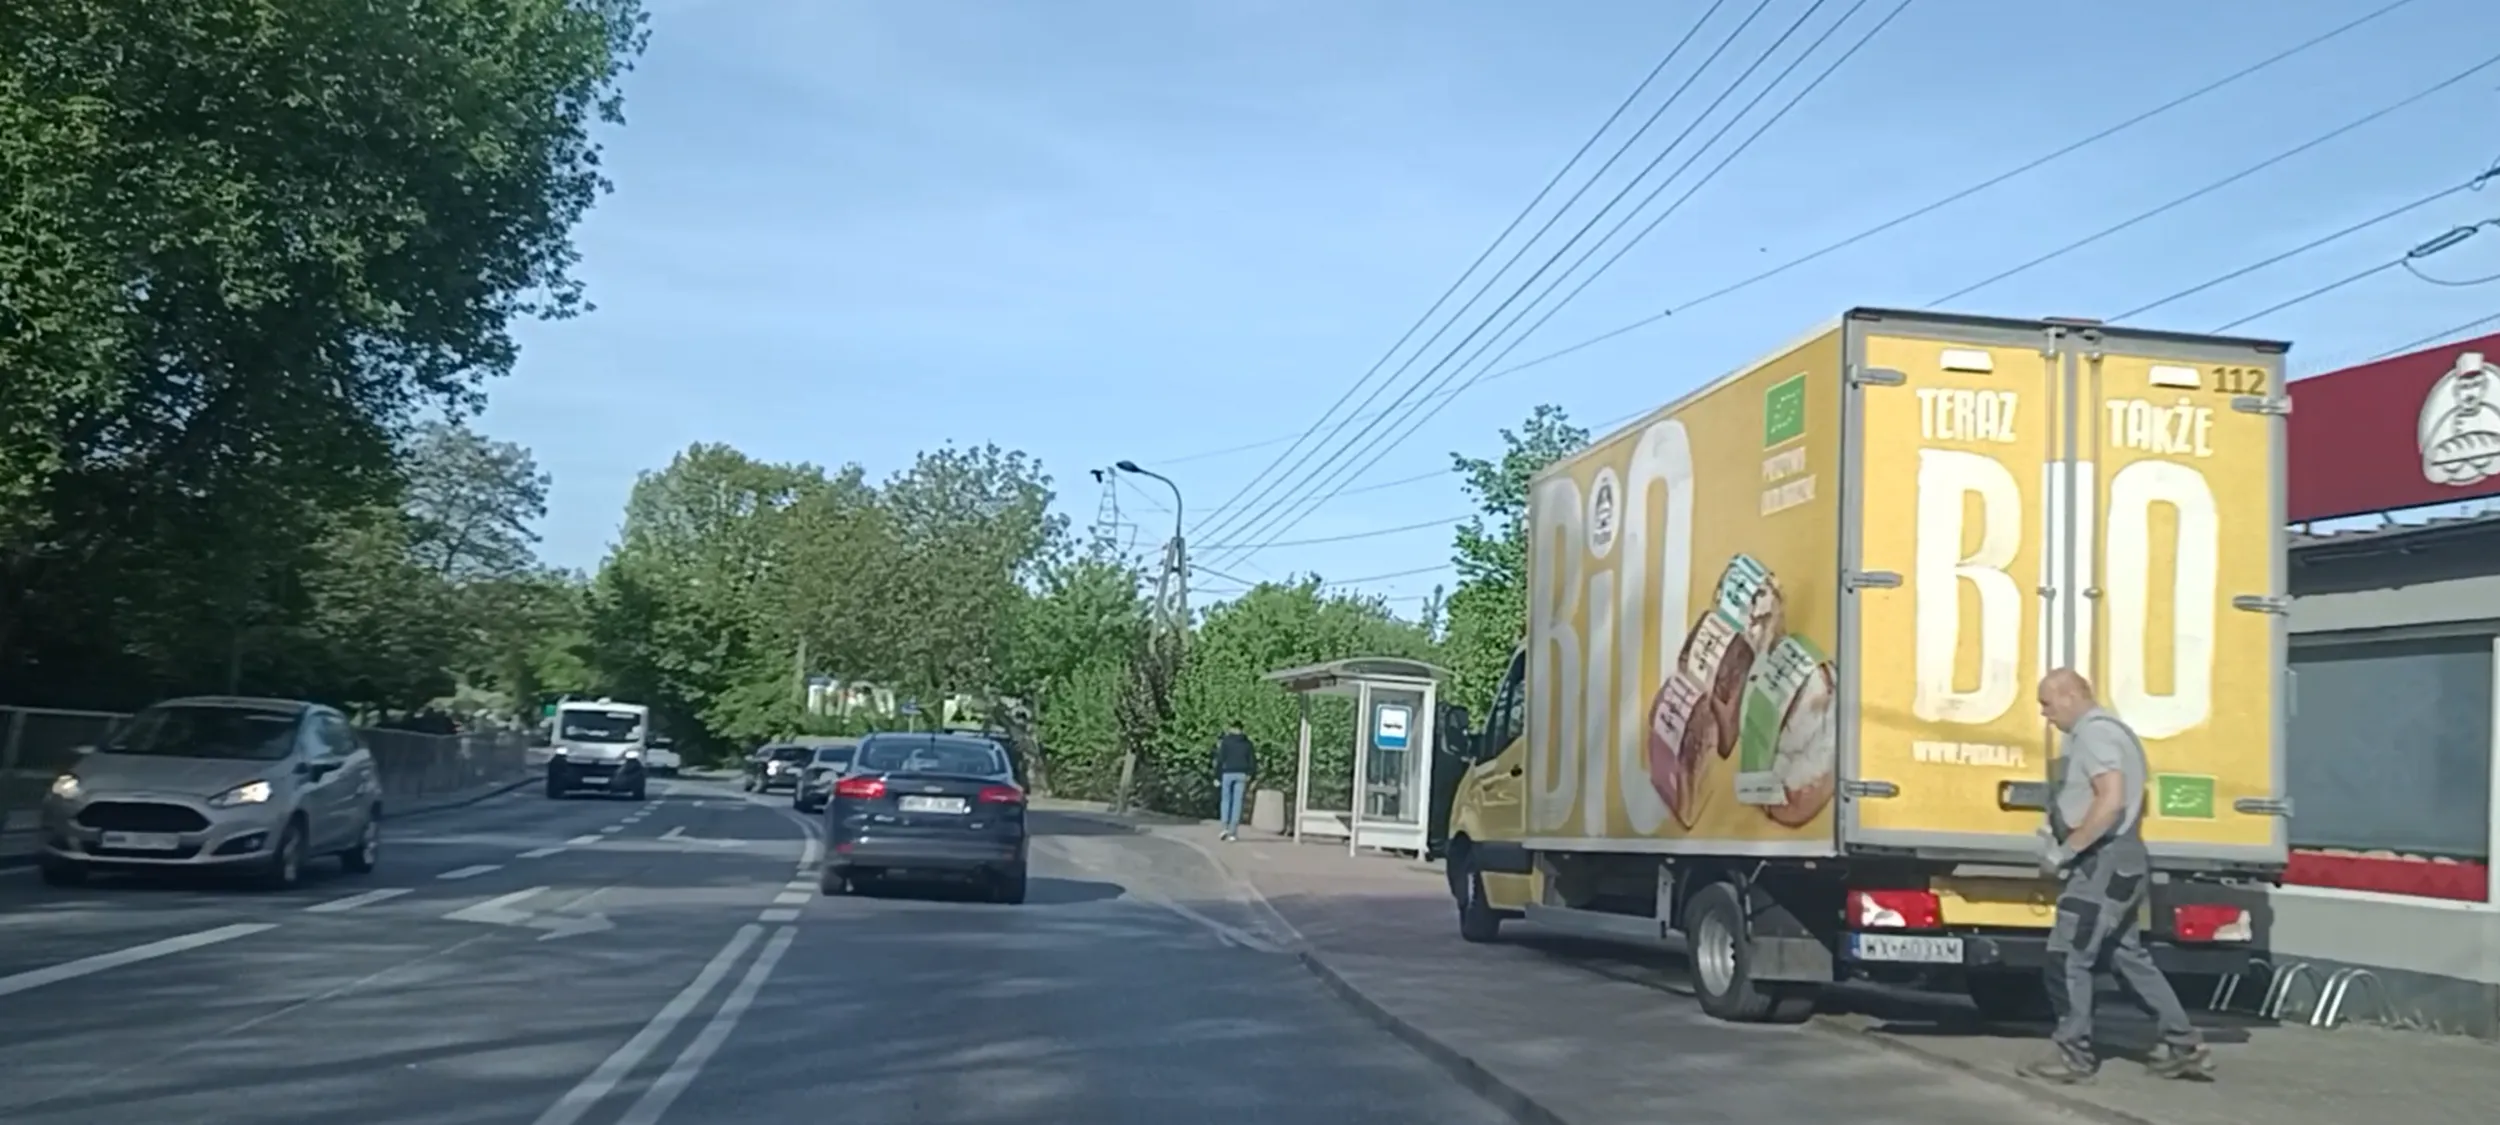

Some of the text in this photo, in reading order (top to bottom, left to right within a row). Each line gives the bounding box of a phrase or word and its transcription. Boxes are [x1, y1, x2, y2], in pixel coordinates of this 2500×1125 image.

[2212, 367, 2266, 396] 112
[1916, 388, 2214, 458] TERAZ TAKŻE
[1914, 449, 2218, 740] BIO
